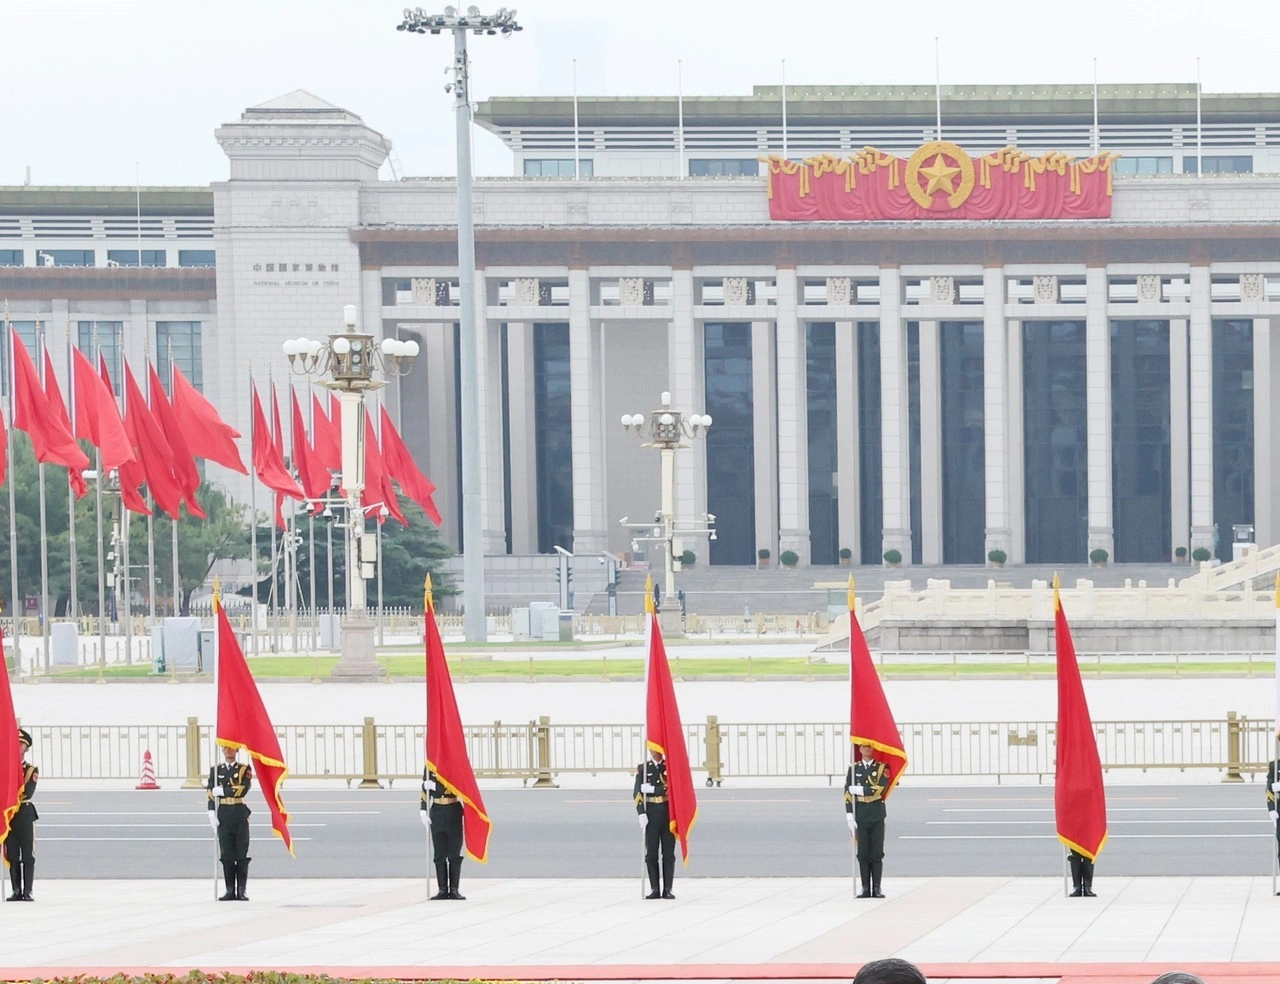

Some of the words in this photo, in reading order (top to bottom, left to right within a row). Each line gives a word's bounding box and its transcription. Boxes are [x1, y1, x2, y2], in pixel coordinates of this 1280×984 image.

[253, 263, 339, 272] 中国国家博物馆
